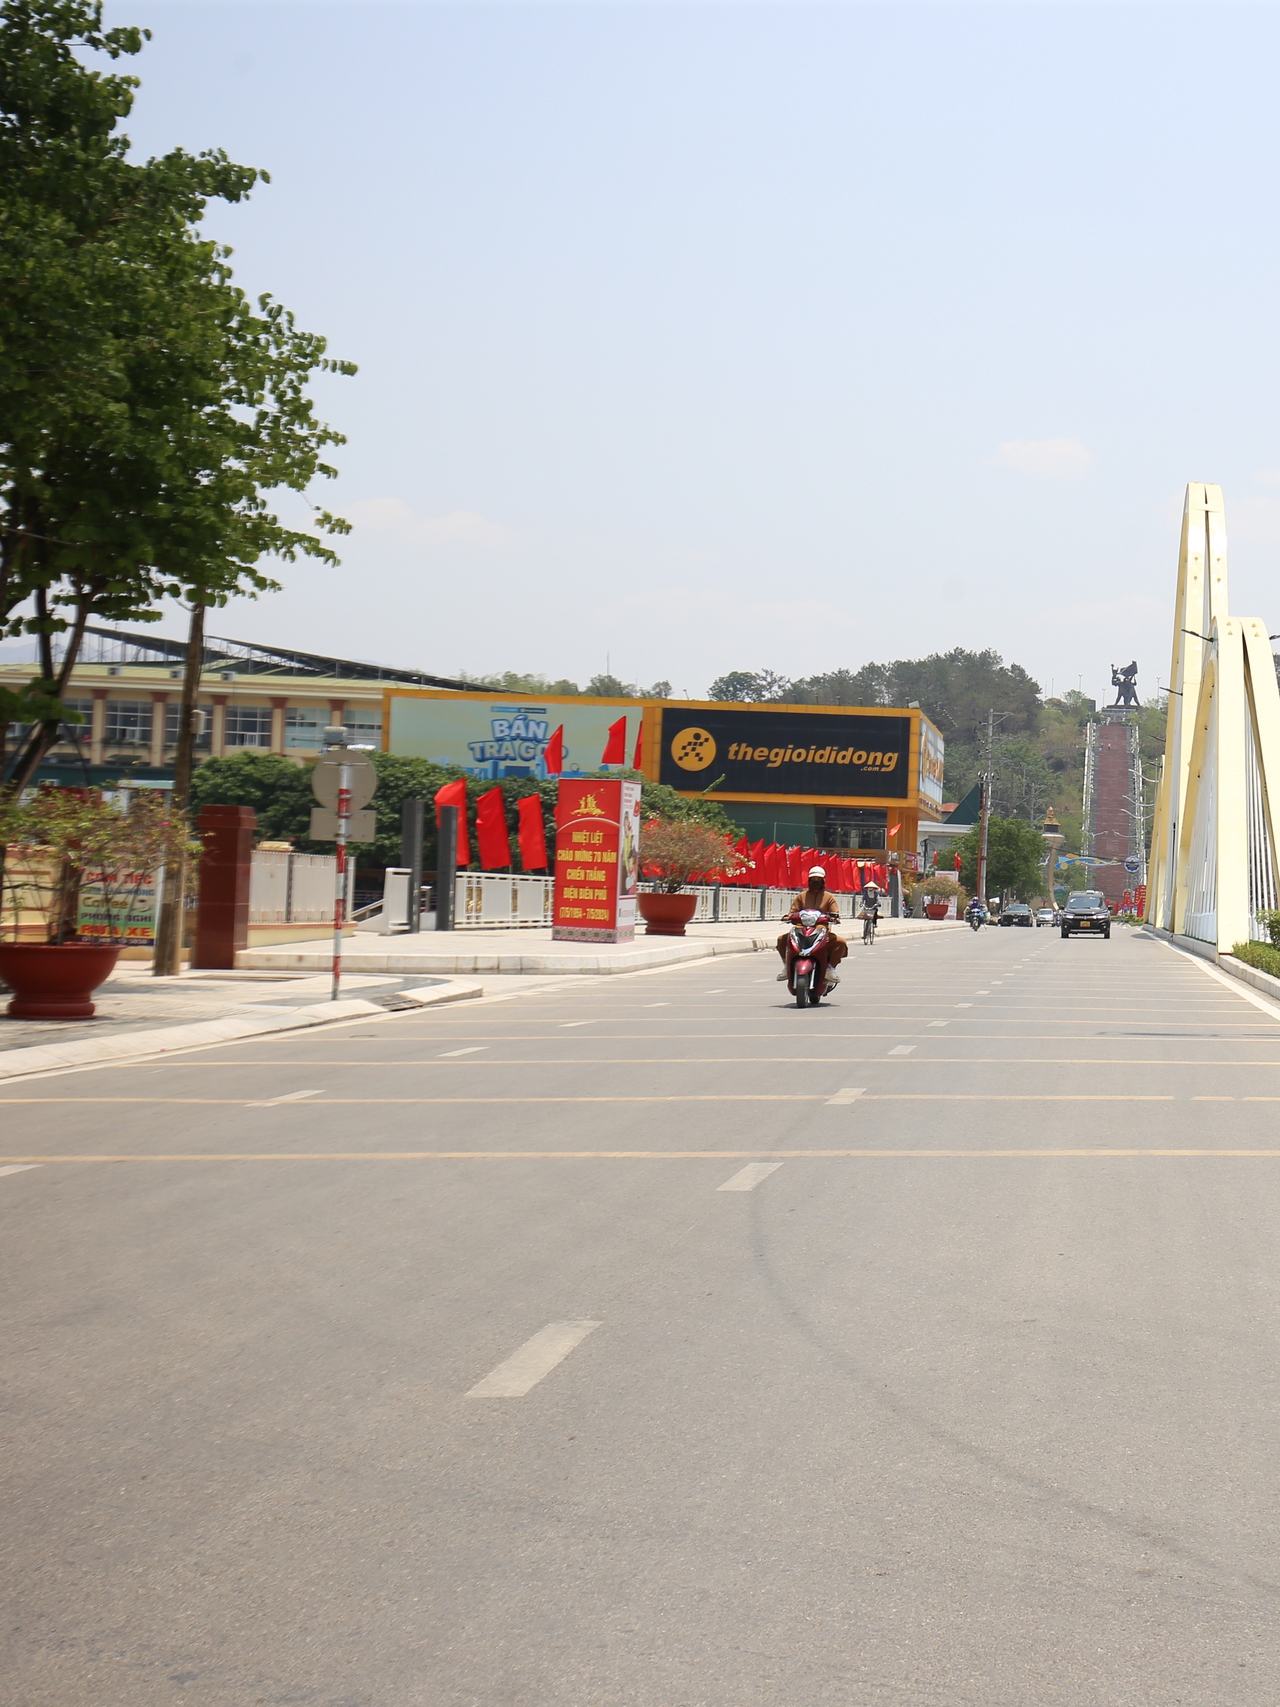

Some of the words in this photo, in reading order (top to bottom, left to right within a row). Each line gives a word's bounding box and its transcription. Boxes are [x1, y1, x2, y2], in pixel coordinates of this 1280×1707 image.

[492, 714, 548, 742] BÁN
[468, 737, 517, 762] TRẢ
[727, 742, 899, 772] thegioididong
[572, 830, 590, 846] NHIỆT
[590, 830, 604, 846] LIỆT
[593, 851, 602, 863] 70
[127, 926, 152, 937] XE
